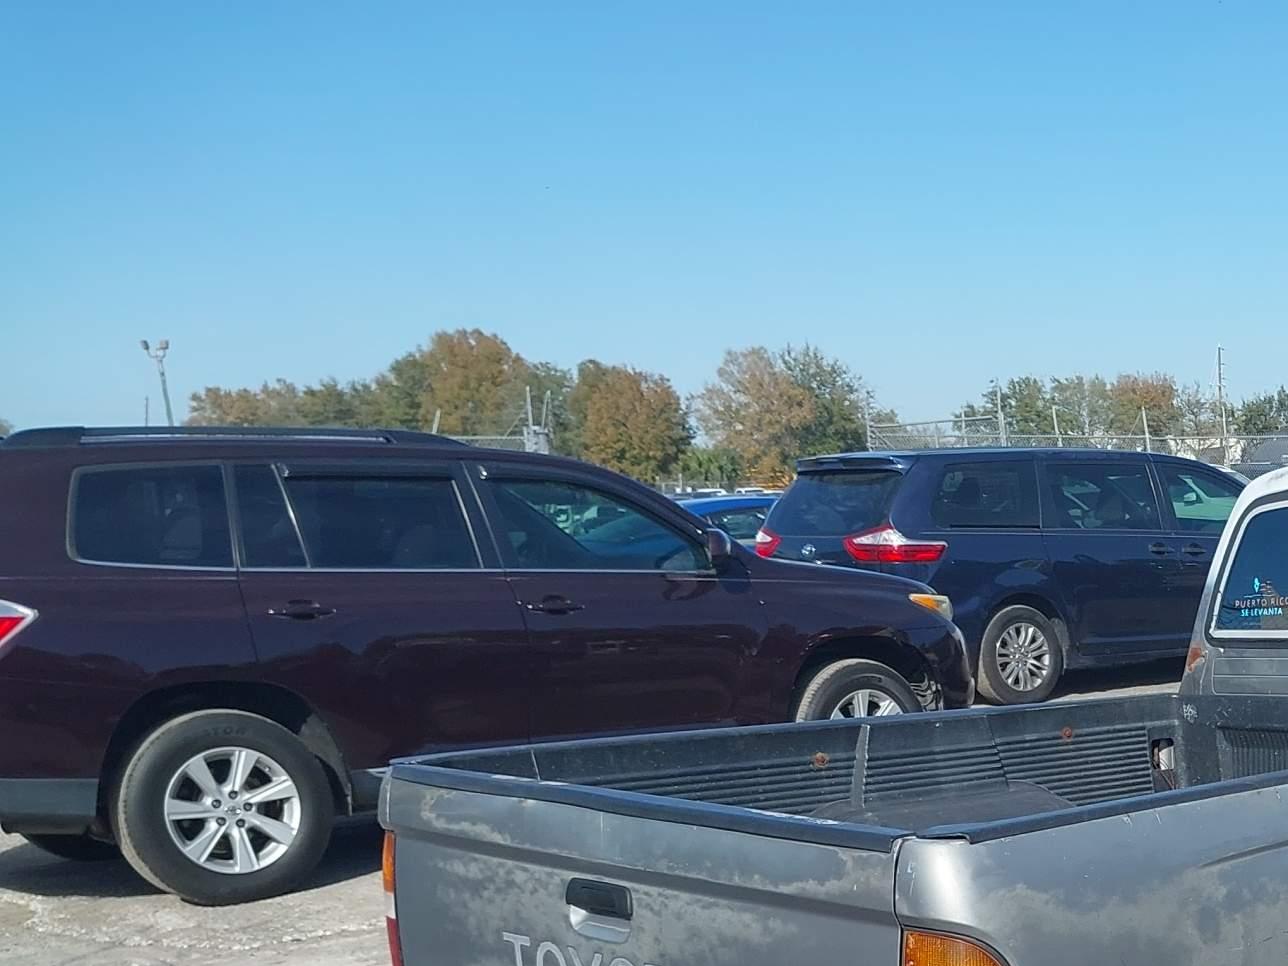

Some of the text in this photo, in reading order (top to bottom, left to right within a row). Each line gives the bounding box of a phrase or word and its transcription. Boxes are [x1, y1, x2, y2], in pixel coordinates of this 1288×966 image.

[1235, 599, 1268, 608] PUERTO
[1240, 607, 1283, 617] SE LEVANTA
